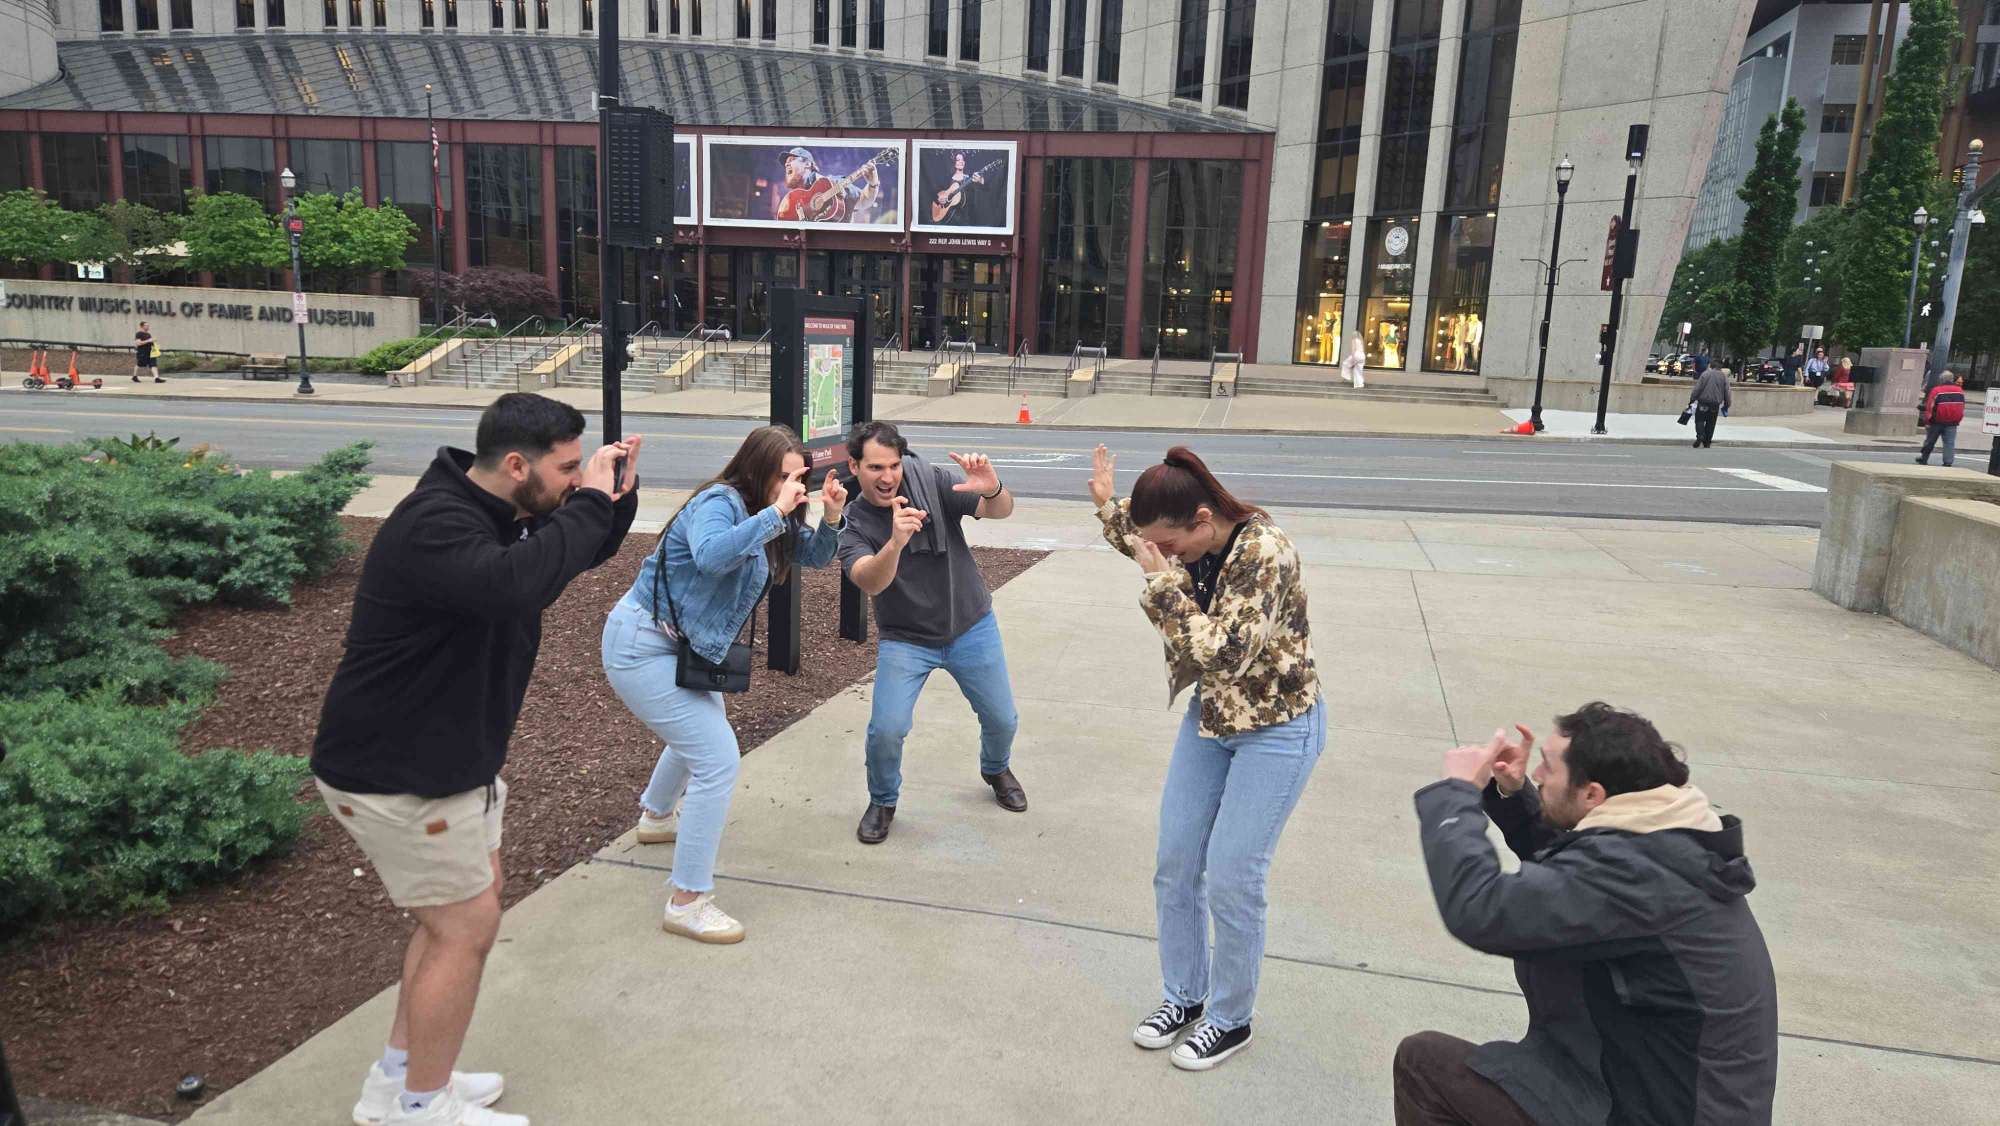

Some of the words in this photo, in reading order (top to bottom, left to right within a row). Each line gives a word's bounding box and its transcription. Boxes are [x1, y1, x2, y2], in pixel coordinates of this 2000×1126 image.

[78, 297, 131, 314] MUSIC
[136, 299, 176, 317] HALL
[180, 301, 203, 318] OF
[207, 303, 253, 321] FAME
[258, 306, 294, 323] AND
